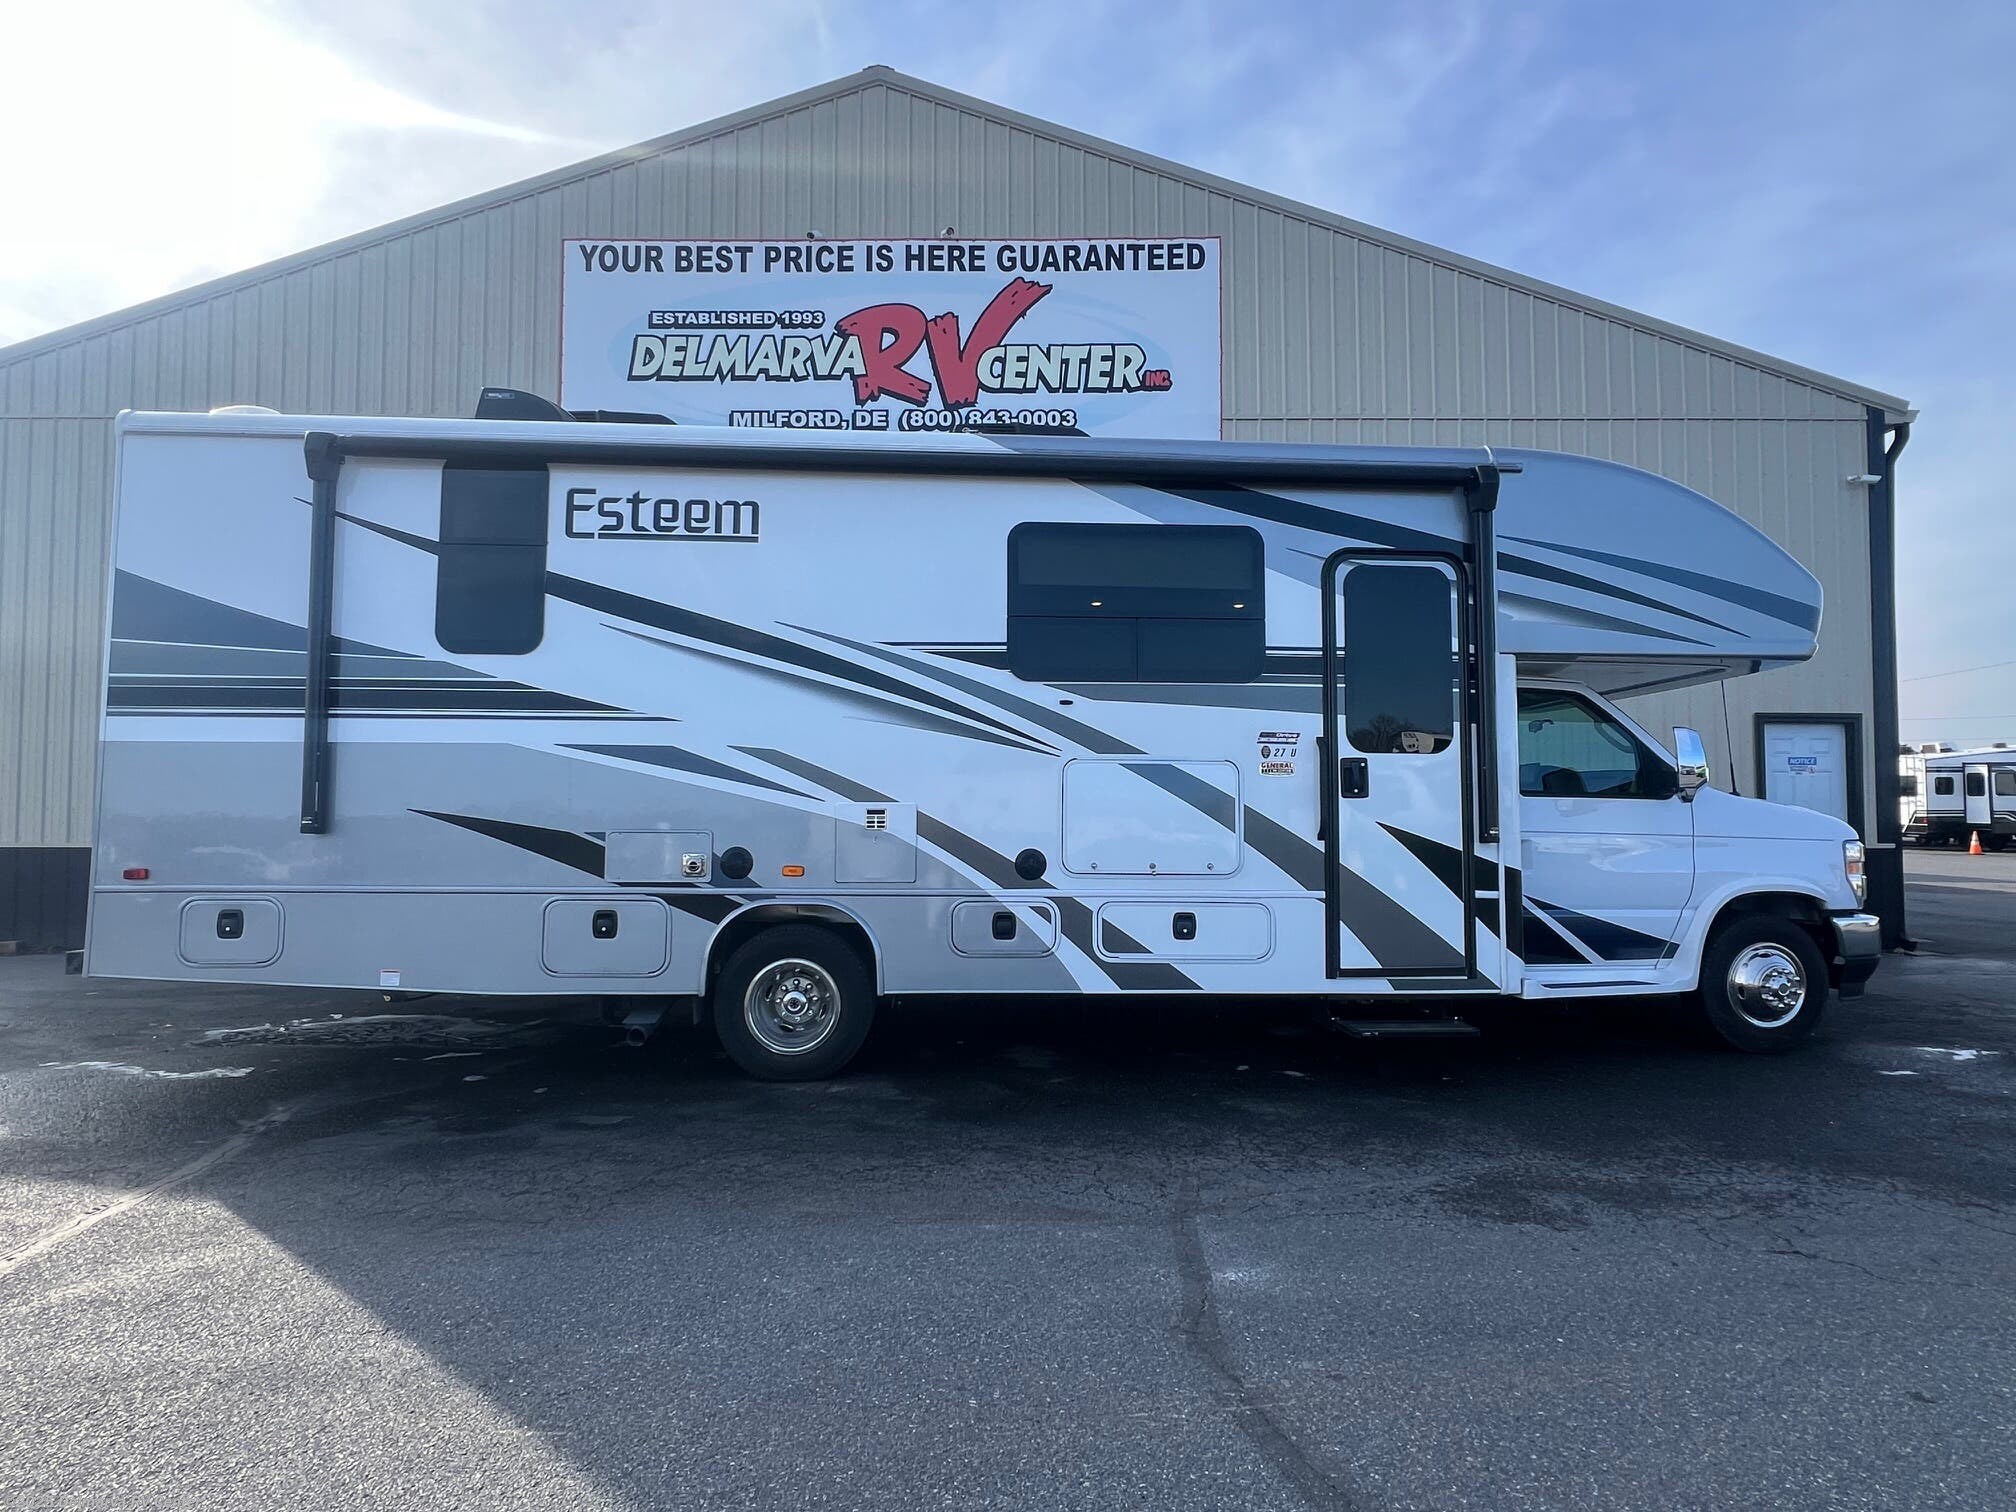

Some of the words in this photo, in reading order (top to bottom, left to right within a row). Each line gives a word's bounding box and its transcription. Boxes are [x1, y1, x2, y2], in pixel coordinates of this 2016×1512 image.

[579, 244, 664, 273] YOUR
[674, 245, 753, 273] BEST
[764, 245, 854, 273] PRICE
[866, 245, 894, 272] IS
[905, 244, 986, 272] HERE
[997, 243, 1206, 272] GUARANTEED
[650, 311, 777, 327] ESTABLISHED
[780, 311, 825, 326] 1993
[628, 334, 868, 383] DELMARVA
[835, 277, 1053, 409] RV
[977, 343, 1147, 392] CENTER
[732, 411, 849, 430] MILFORD,
[855, 410, 888, 428] DE
[901, 410, 962, 433] (800)
[967, 410, 1077, 428] 843-0003
[565, 488, 760, 540] Esteem
[1274, 748, 1286, 758] 27
